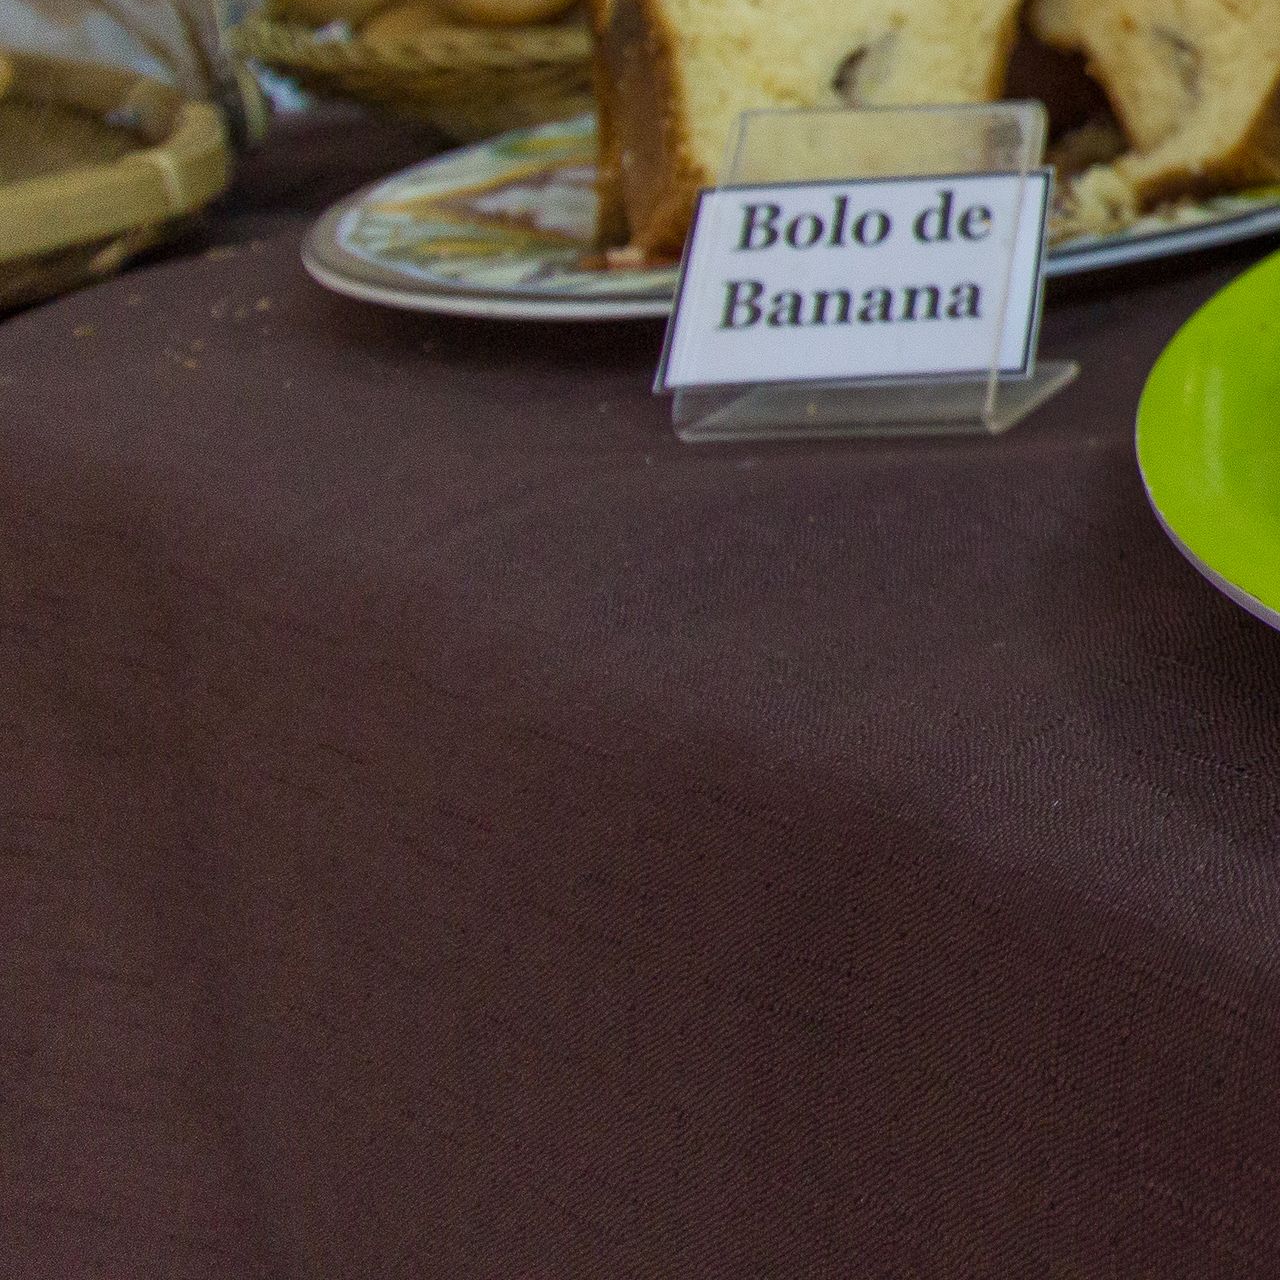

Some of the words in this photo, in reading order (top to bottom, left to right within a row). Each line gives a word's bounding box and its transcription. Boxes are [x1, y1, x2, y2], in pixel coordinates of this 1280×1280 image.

[735, 193, 892, 252] Bolo
[911, 190, 992, 244] de
[718, 278, 982, 331] Banana
